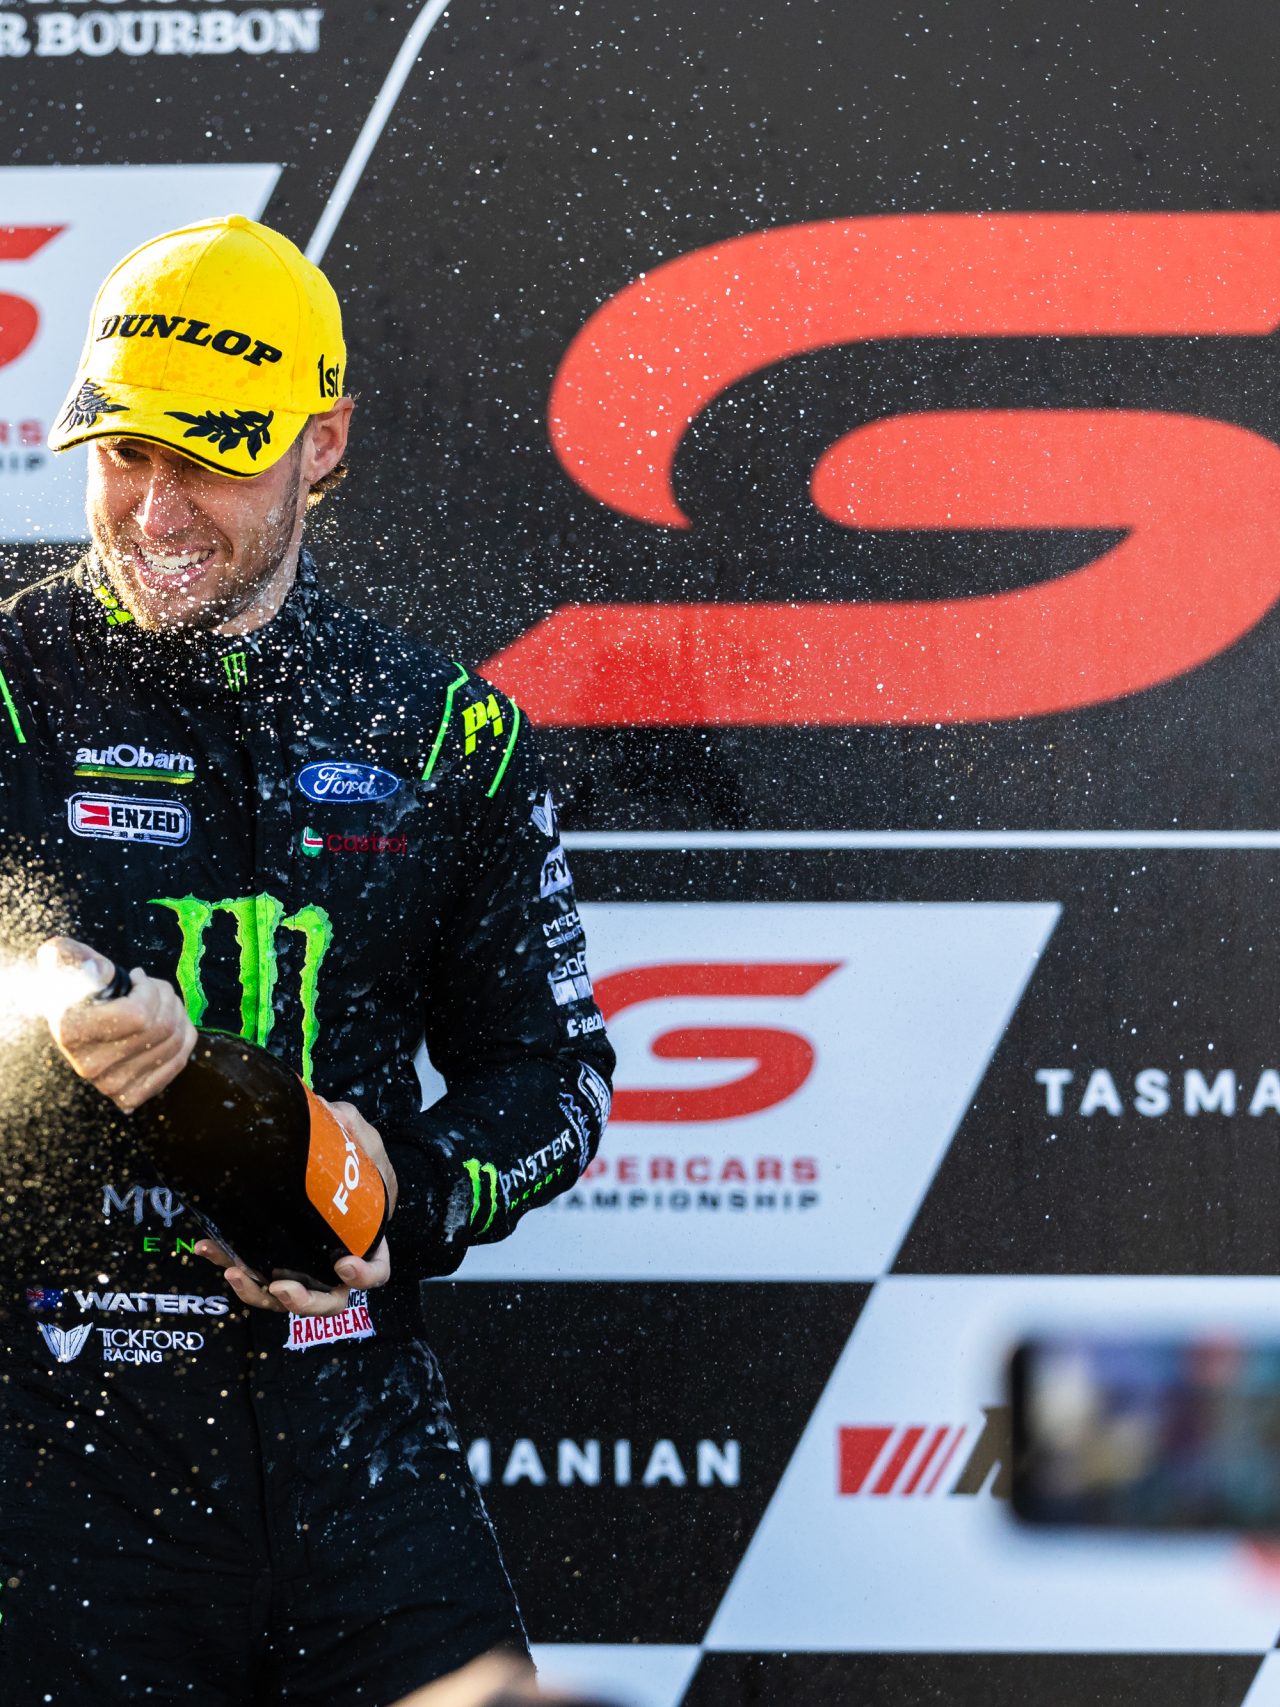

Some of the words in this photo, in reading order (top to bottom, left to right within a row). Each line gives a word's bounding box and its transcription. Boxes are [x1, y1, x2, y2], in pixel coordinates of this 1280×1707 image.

[35, 9, 323, 57] BOURBON
[96, 313, 283, 367] DUNLOP
[317, 353, 340, 399] 1st
[461, 693, 504, 757] P1
[313, 767, 377, 797] Ford
[111, 806, 181, 834] ENZED
[326, 832, 407, 855] Castrol
[72, 1290, 230, 1316] WATERS
[95, 1328, 205, 1351] TICKFORD
[293, 1306, 373, 1344] RACEGEAR
[103, 1348, 163, 1363] RACING
